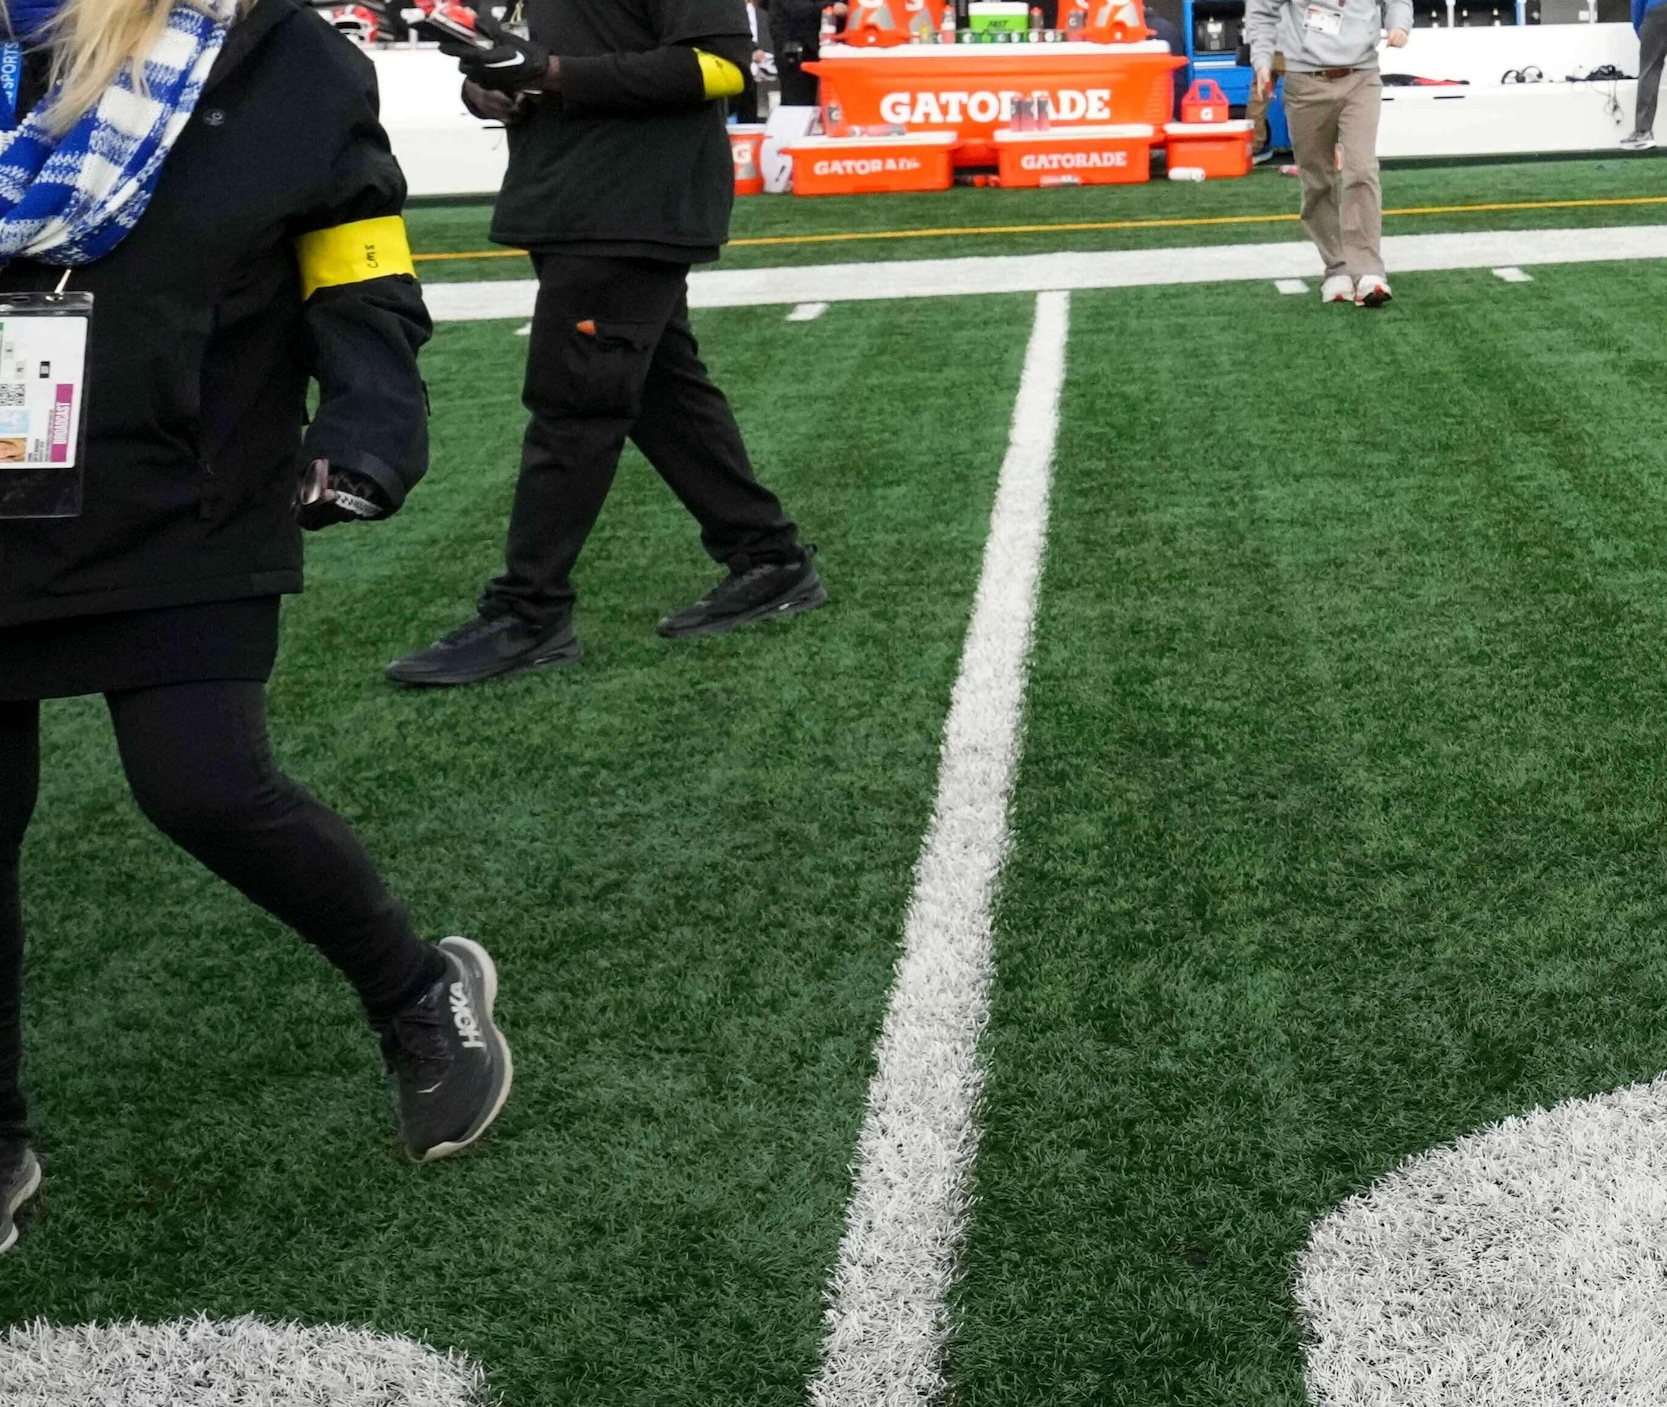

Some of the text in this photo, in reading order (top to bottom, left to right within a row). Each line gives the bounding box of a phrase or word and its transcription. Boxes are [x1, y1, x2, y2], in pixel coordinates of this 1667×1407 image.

[1, 41, 20, 89] SPORTS
[1021, 151, 1127, 171] GATORADE
[53, 401, 72, 446] BROADCAST
[450, 980, 487, 1050] HOKA
